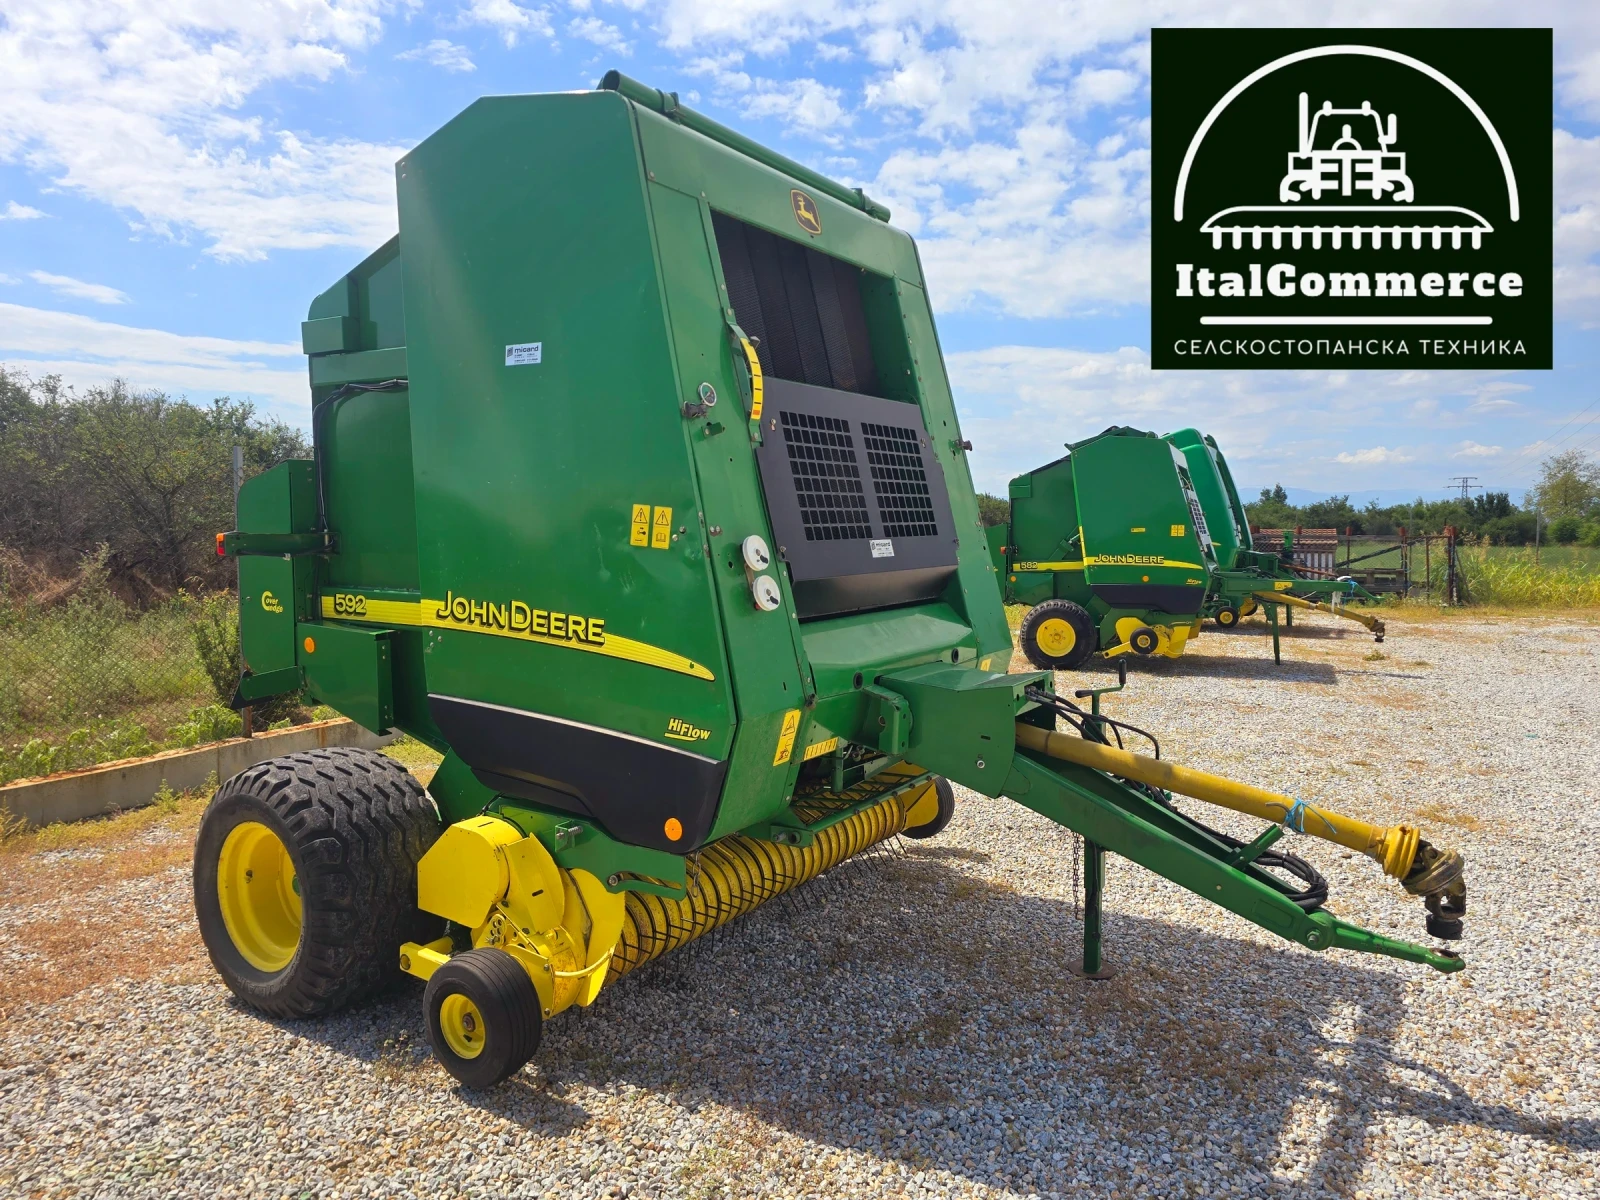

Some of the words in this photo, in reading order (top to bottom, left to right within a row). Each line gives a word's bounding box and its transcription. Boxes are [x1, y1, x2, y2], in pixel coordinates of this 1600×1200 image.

[1020, 562, 1038, 570] 582
[334, 593, 367, 617] 592
[436, 590, 507, 629] JOHN
[508, 599, 606, 647] DEERE
[667, 717, 711, 740] HiFlow
